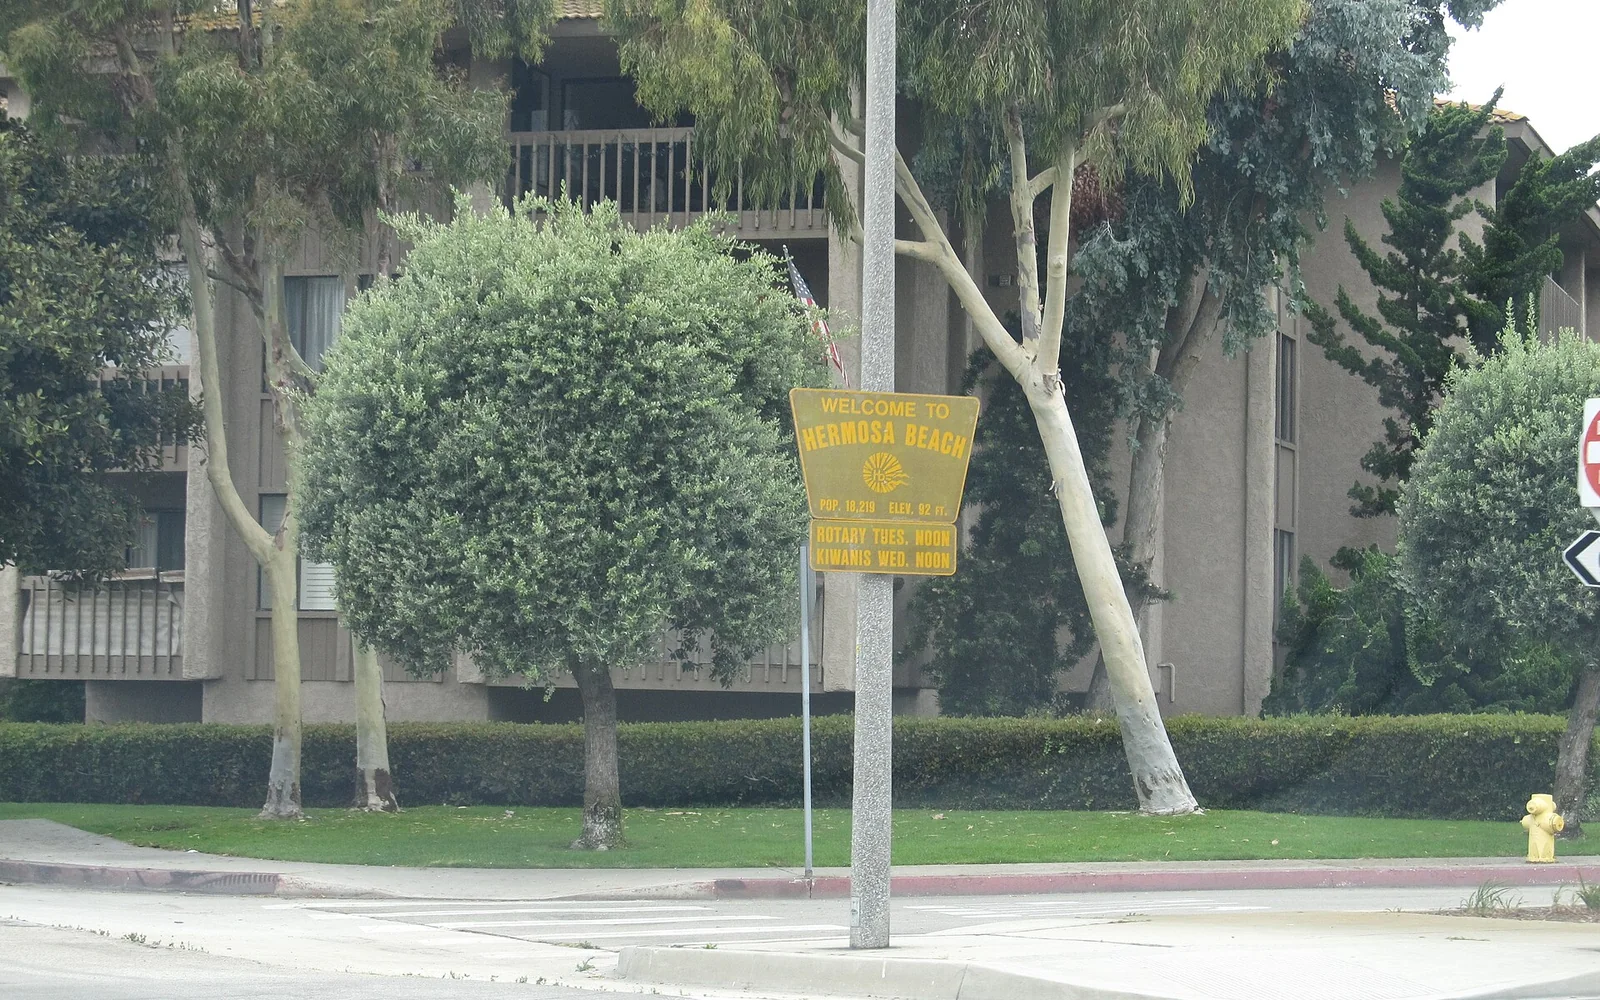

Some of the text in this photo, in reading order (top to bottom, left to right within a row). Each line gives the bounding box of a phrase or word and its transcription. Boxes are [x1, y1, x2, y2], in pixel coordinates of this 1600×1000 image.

[822, 397, 950, 418] WELCOME TO
[802, 420, 967, 459] HERMOSA BEACH
[820, 500, 948, 516] POP. 18,219 ELEV. 92 FT.
[816, 526, 950, 546] ROTARY TUES. NOON
[816, 548, 950, 569] KIWANIS WED. NOON
